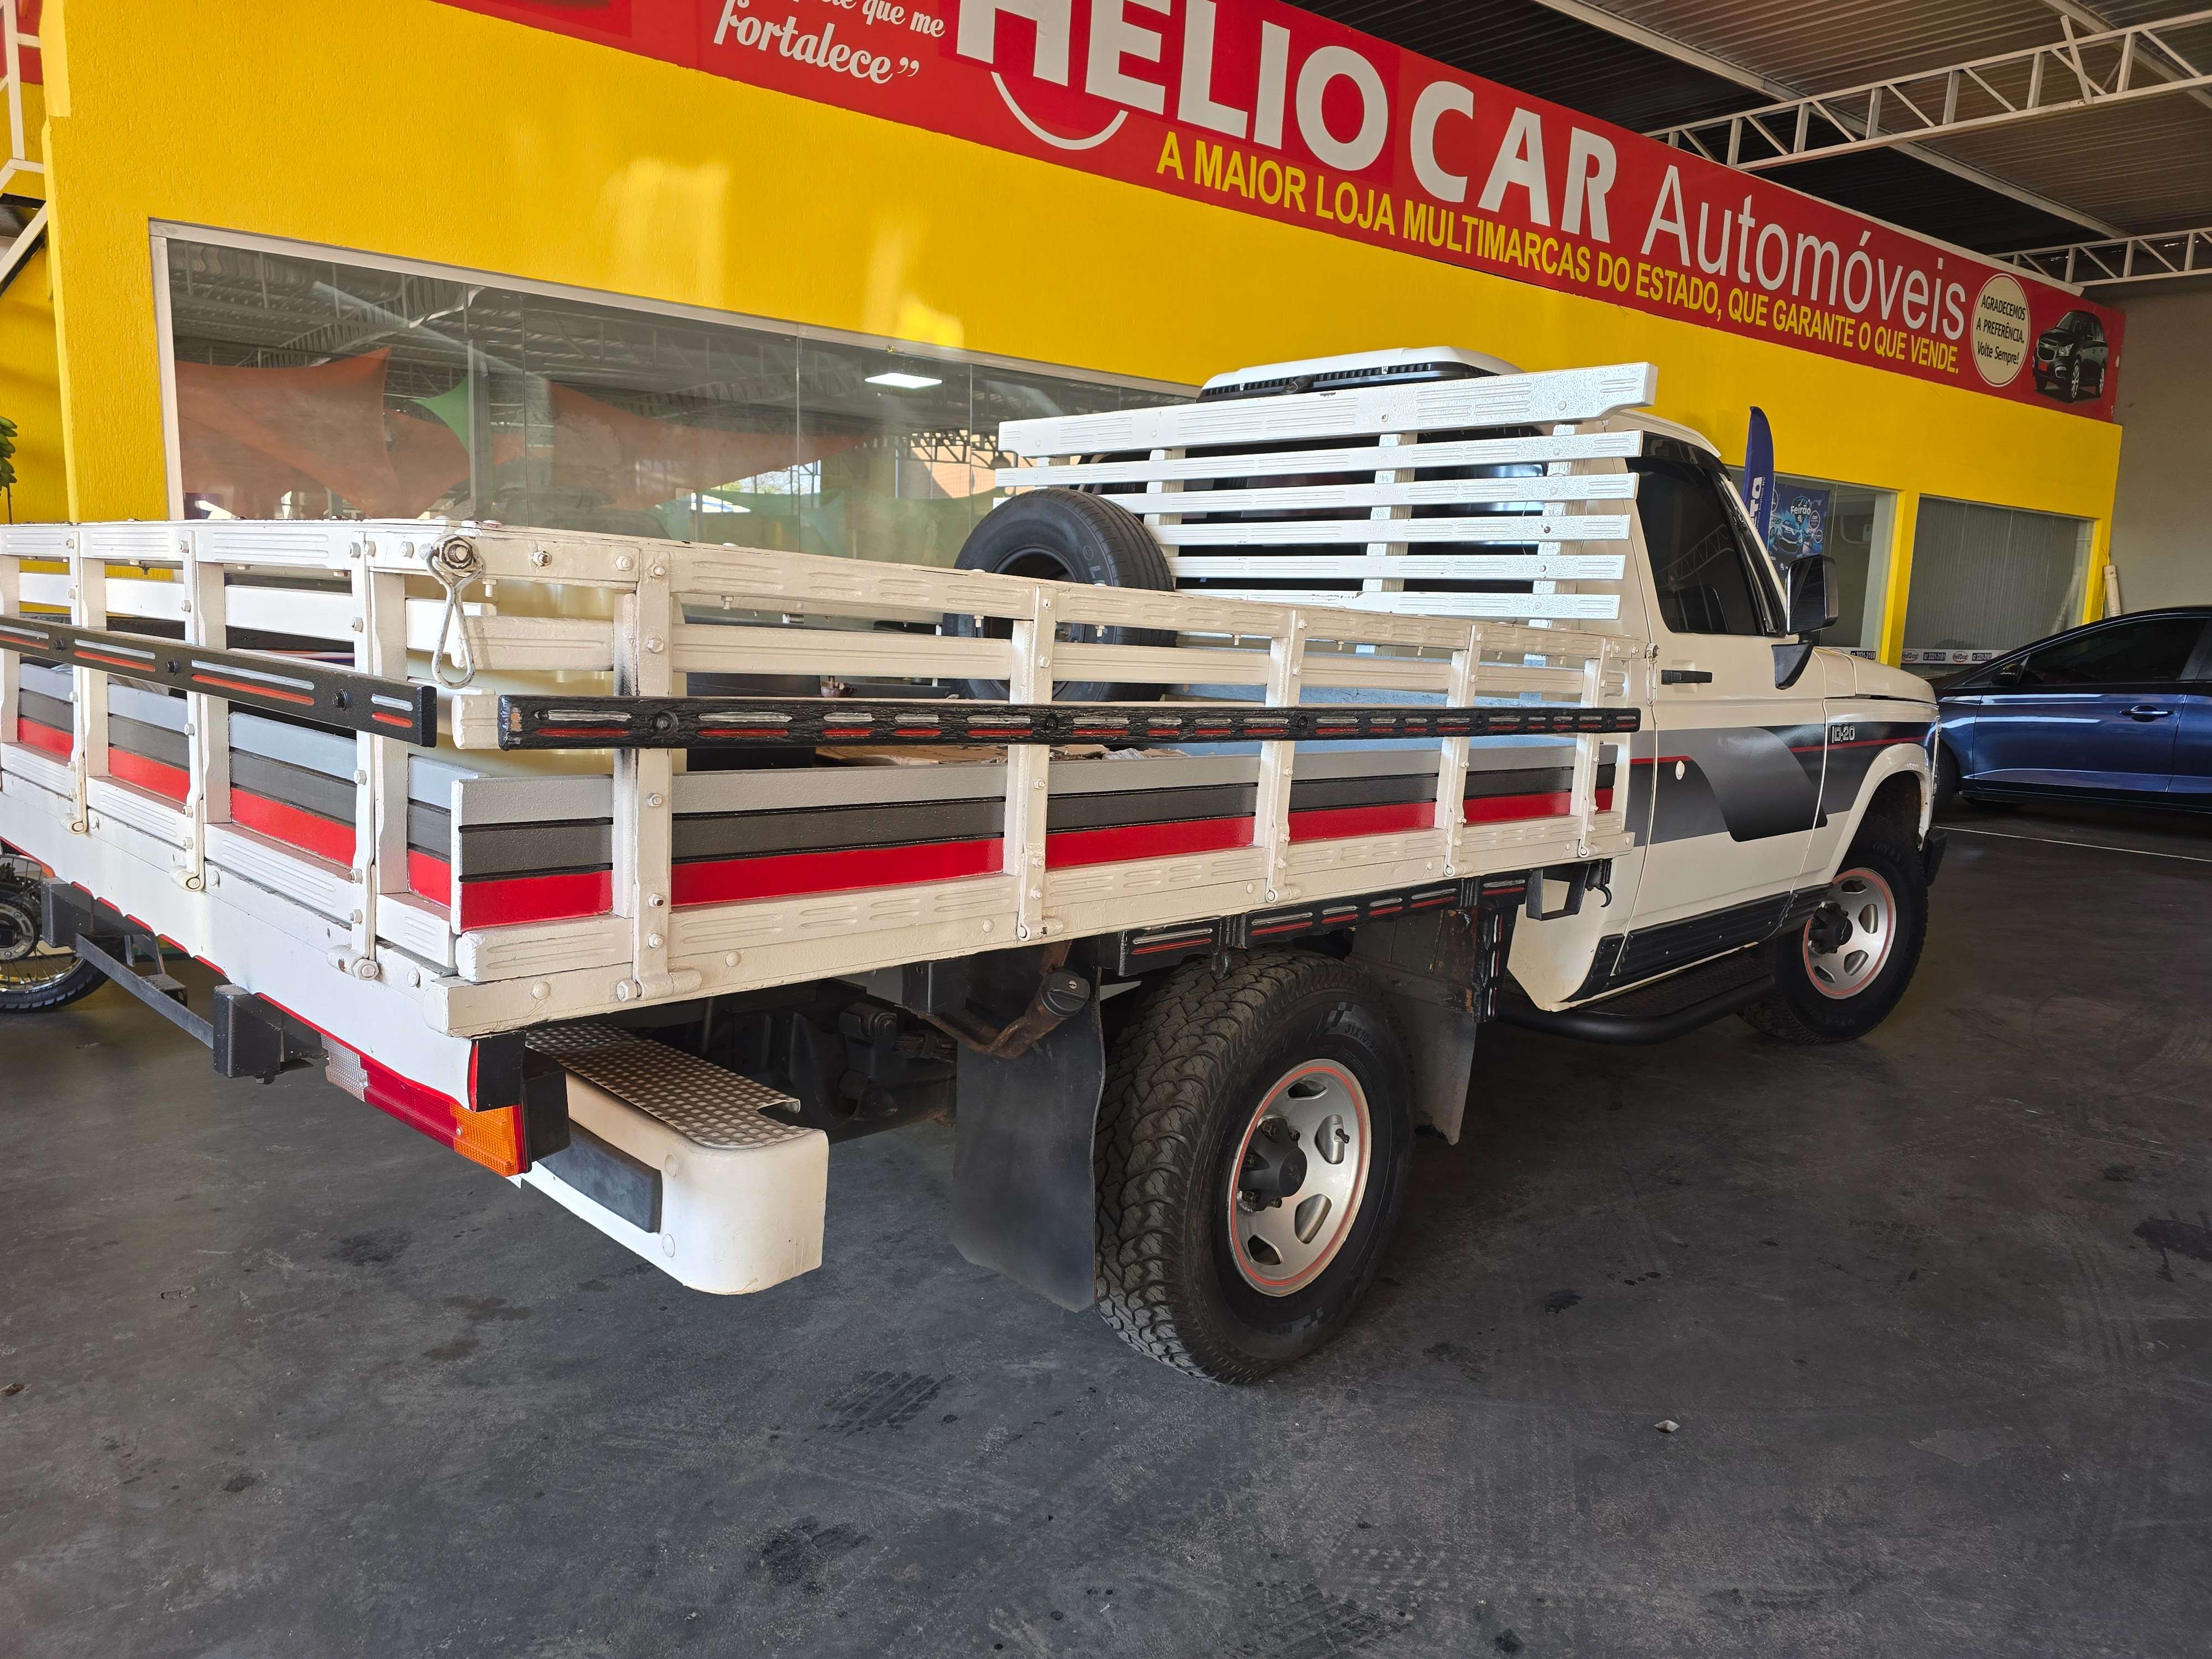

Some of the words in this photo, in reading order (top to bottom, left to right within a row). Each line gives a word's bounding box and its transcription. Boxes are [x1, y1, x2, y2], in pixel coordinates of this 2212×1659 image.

[862, 0, 905, 25] que
[910, 11, 945, 37] me
[1410, 81, 1617, 243] CAR
[1641, 164, 1966, 341] Automóveis
[1157, 132, 1184, 180] A
[1194, 140, 1306, 212] MAIOR
[1316, 176, 1395, 235] LOJA
[1404, 200, 1590, 283] MULTIMARCAS
[1598, 252, 1630, 292] DO
[1636, 263, 1721, 321] ESTADO,
[1729, 289, 1770, 327] QUE
[1772, 299, 1855, 348] GARANTE
[1859, 322, 1871, 352] O
[1875, 327, 1906, 361] QUE
[1911, 335, 1959, 374] VENDE.
[1981, 295, 2026, 321] AGRADECEMOS
[1976, 317, 1981, 331] A
[1983, 319, 2025, 344] PREFERÊNCIA.
[1978, 341, 1993, 358] Volte
[1994, 346, 2020, 366] Sempre!
[1790, 504, 1812, 515] Feirão
